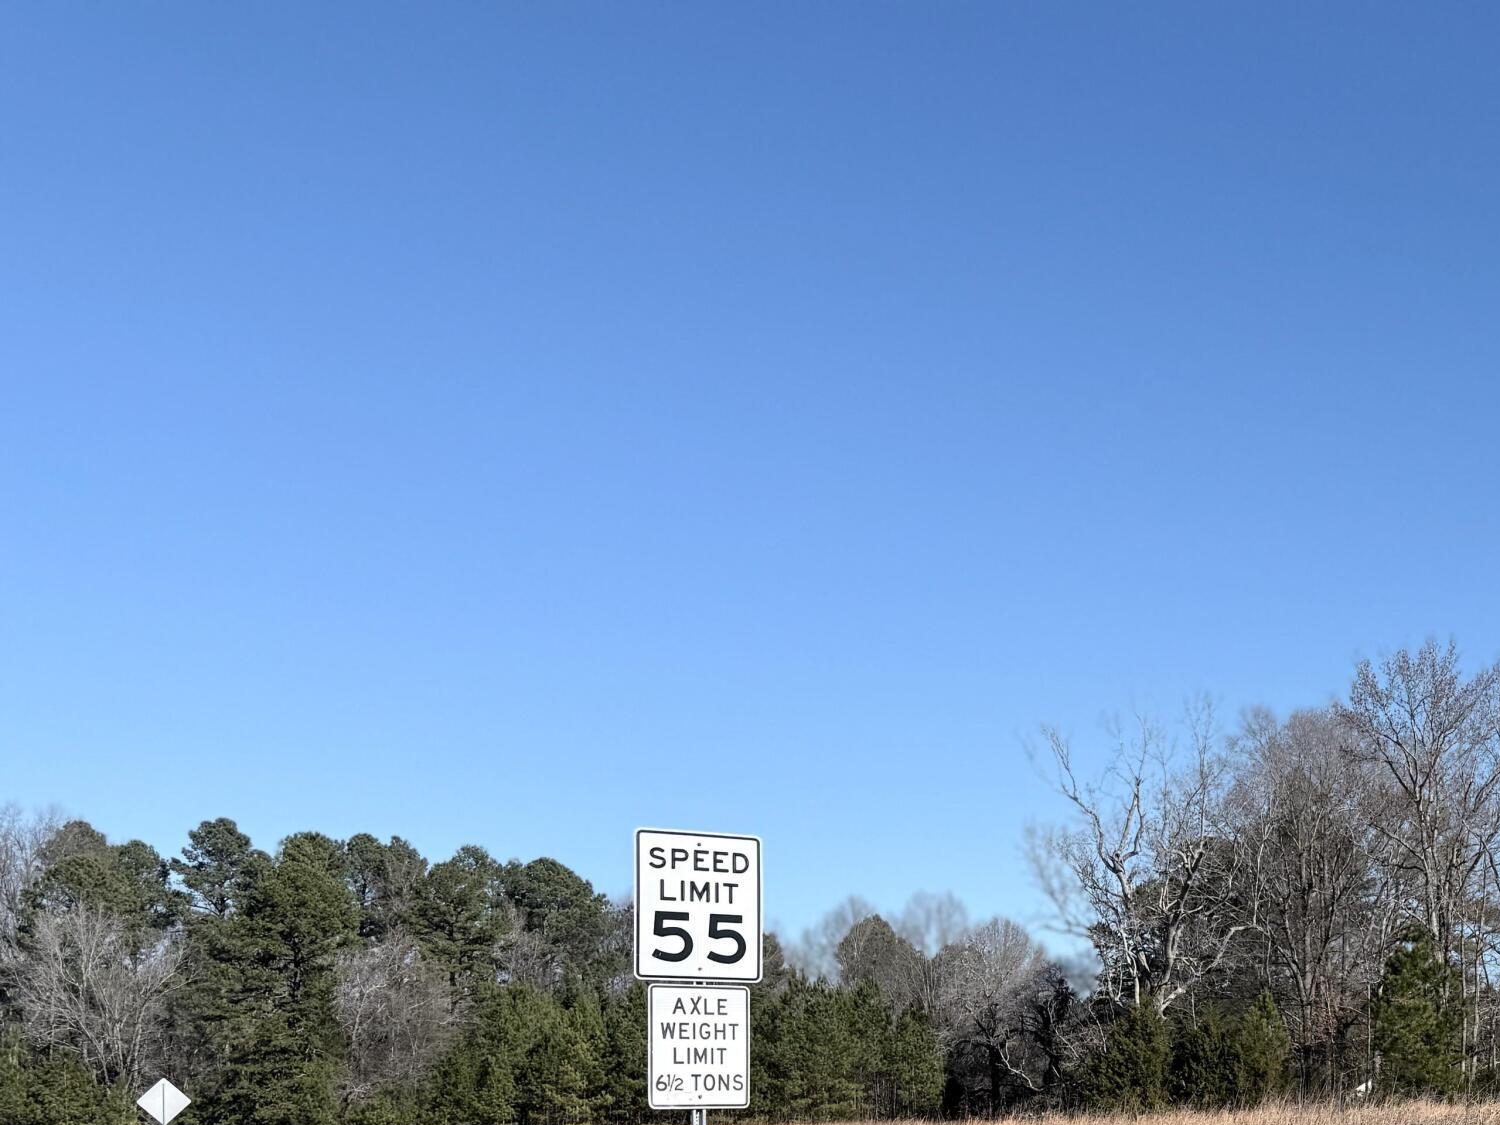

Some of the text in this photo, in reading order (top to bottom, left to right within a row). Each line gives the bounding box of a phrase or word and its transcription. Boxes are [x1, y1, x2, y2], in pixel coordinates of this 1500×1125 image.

[649, 847, 750, 874] SPEED
[660, 879, 739, 904] LIMIT
[652, 911, 747, 964] 55
[672, 997, 728, 1015] AXLE
[661, 1023, 739, 1040] WEIGHT
[673, 1048, 727, 1064] LIMIT
[691, 1074, 744, 1092] TONS
